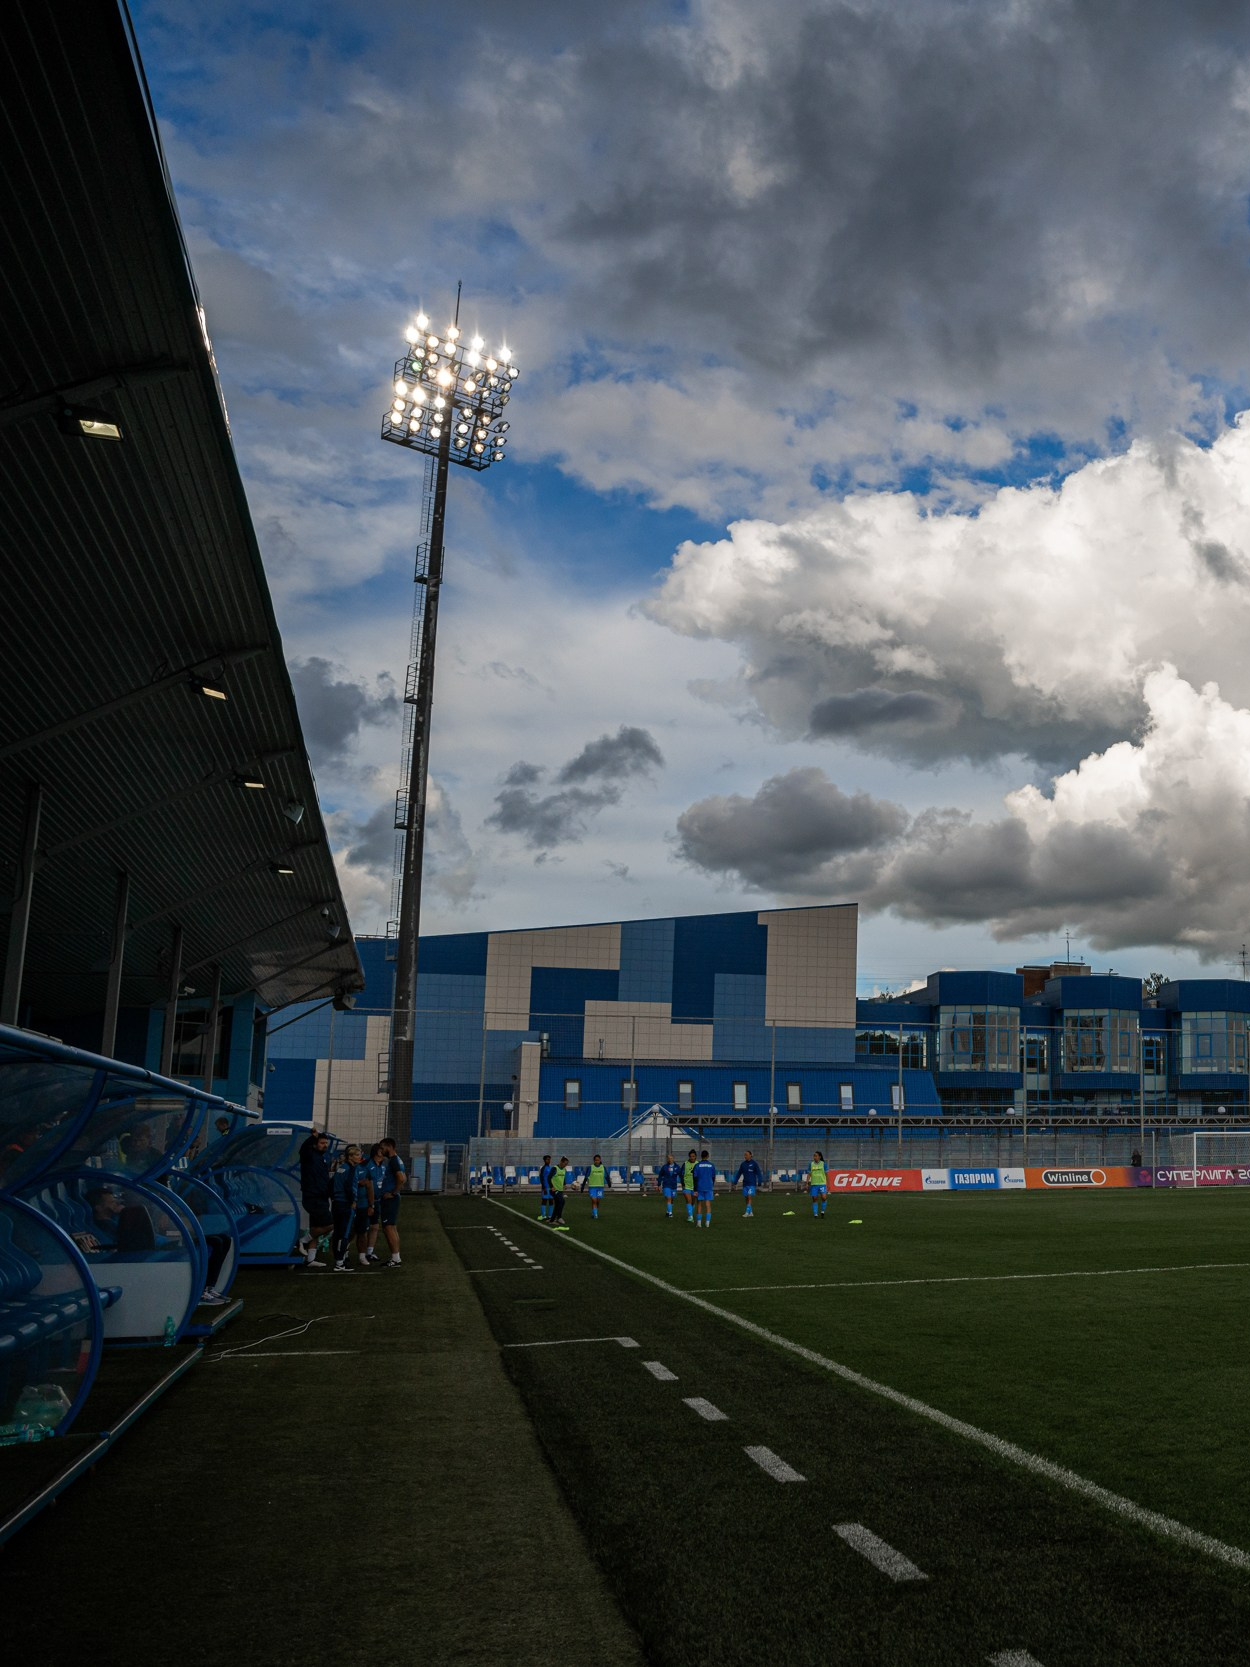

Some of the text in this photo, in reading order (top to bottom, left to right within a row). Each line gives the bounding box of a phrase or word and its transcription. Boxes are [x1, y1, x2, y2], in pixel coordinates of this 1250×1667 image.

[954, 1173, 995, 1184] ГАЗПРОМ
[1047, 1173, 1088, 1183] Winline
[1156, 1169, 1235, 1182] СУПЕРЛИГА
